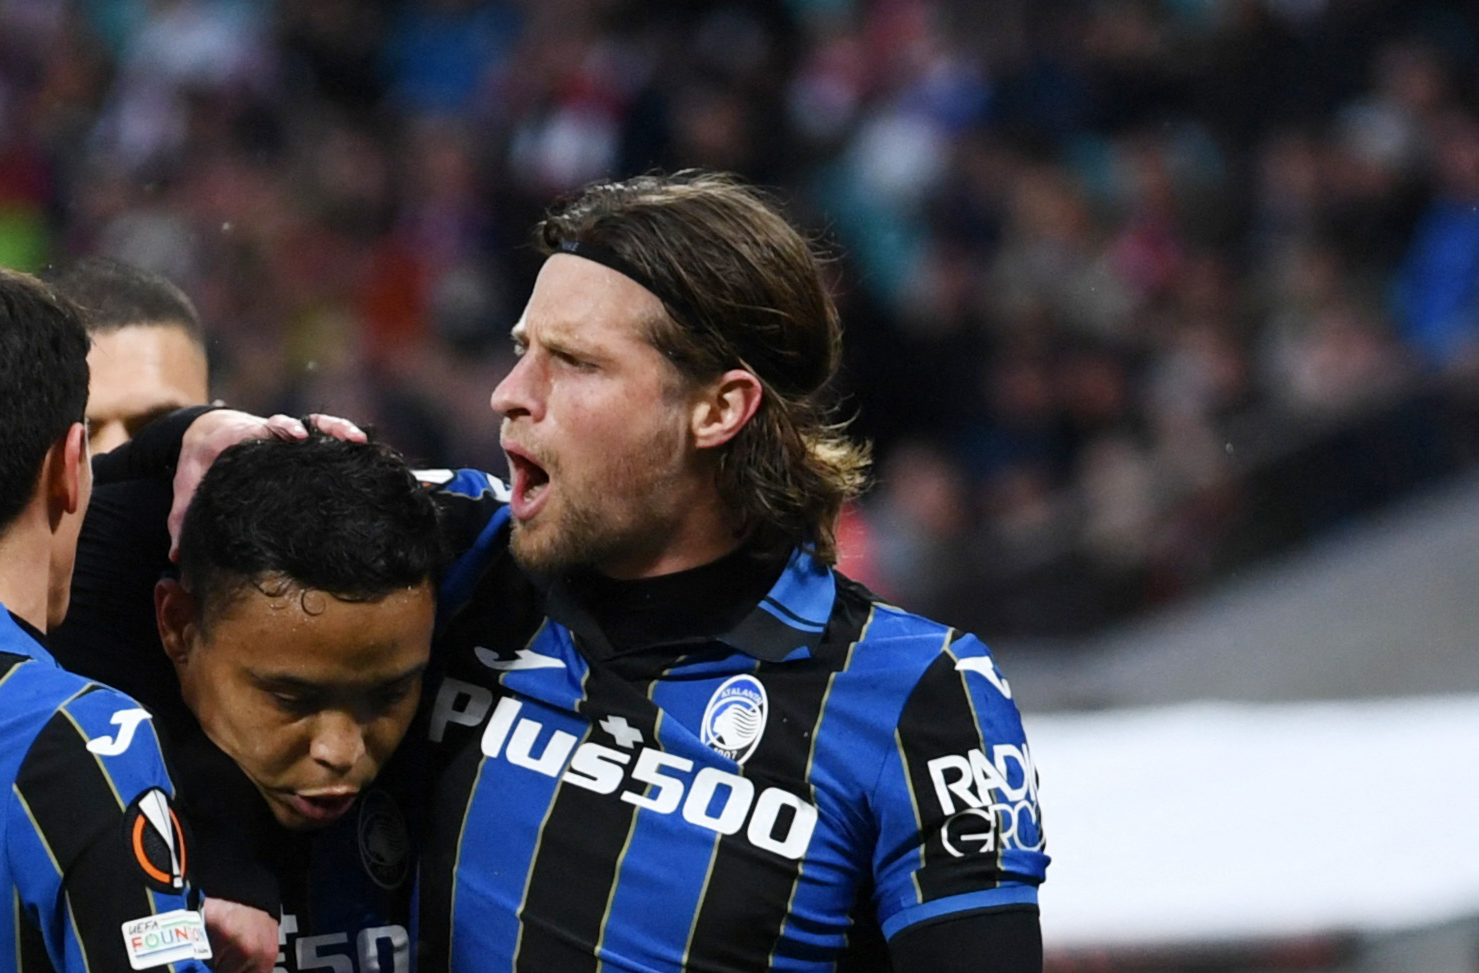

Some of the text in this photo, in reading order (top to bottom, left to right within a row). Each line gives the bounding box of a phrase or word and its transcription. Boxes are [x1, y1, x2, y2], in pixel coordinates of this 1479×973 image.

[429, 677, 818, 859] Plus500
[927, 743, 1039, 816] RADI
[941, 799, 1046, 858] GRO
[129, 920, 159, 936] UEFA
